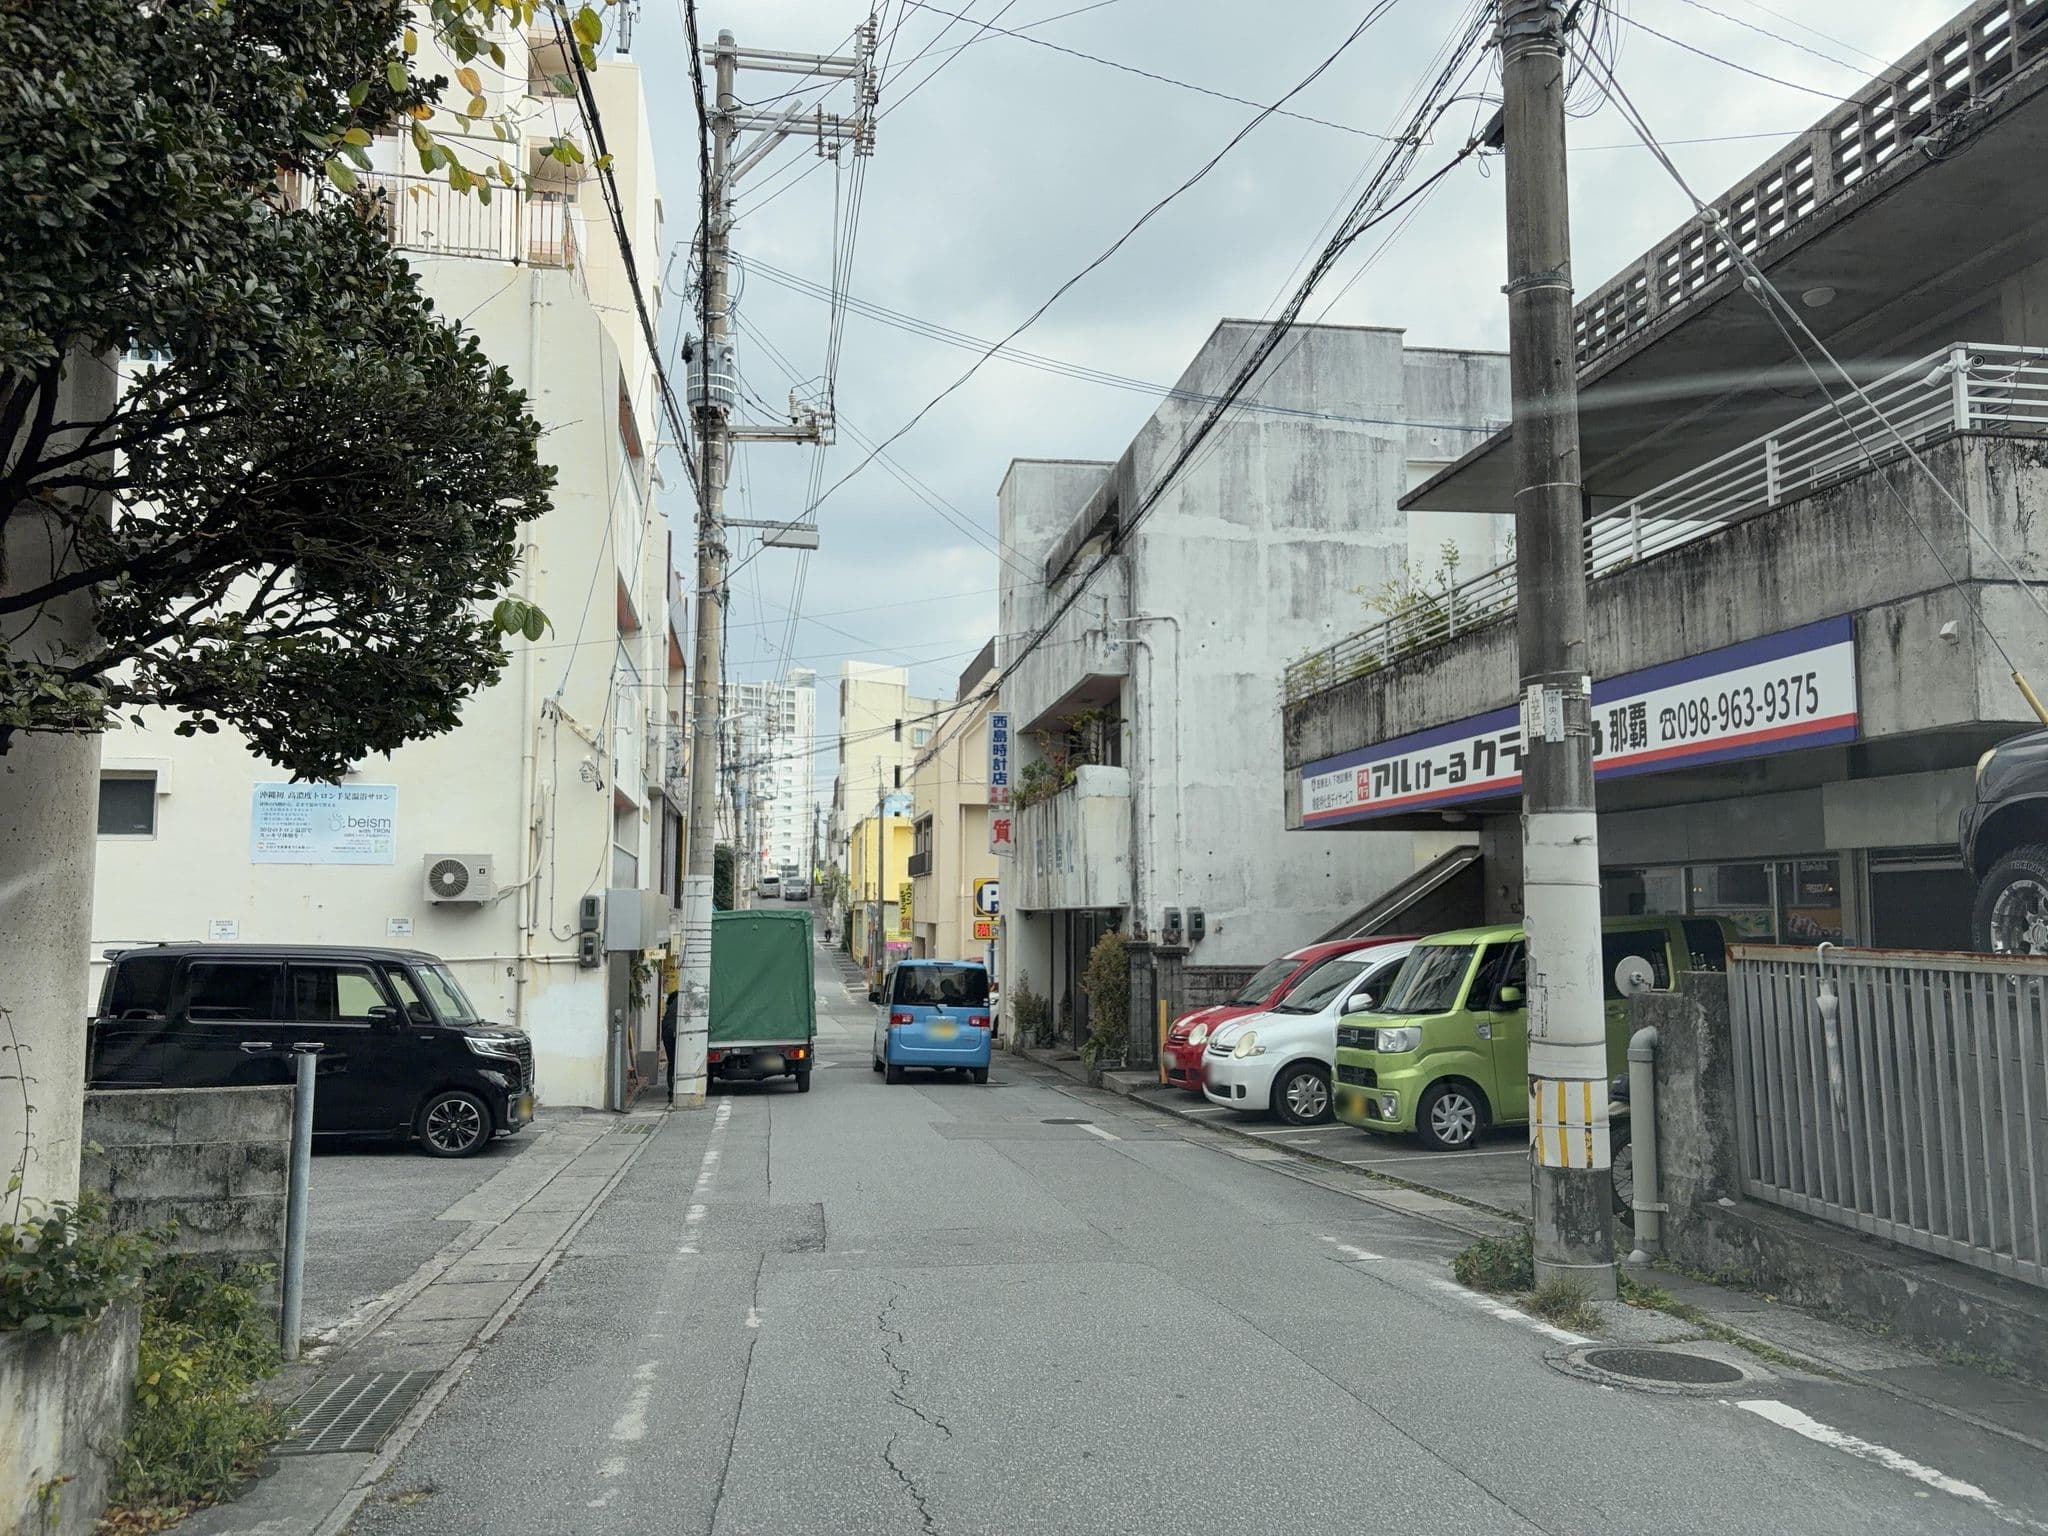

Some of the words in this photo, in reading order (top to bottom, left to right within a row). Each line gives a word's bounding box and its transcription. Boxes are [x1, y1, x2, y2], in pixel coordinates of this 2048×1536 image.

[1609, 701, 1648, 753] 那覇
[992, 715, 1008, 786] 西島時計店
[347, 815, 392, 828] beism
[993, 819, 1012, 844] 質
